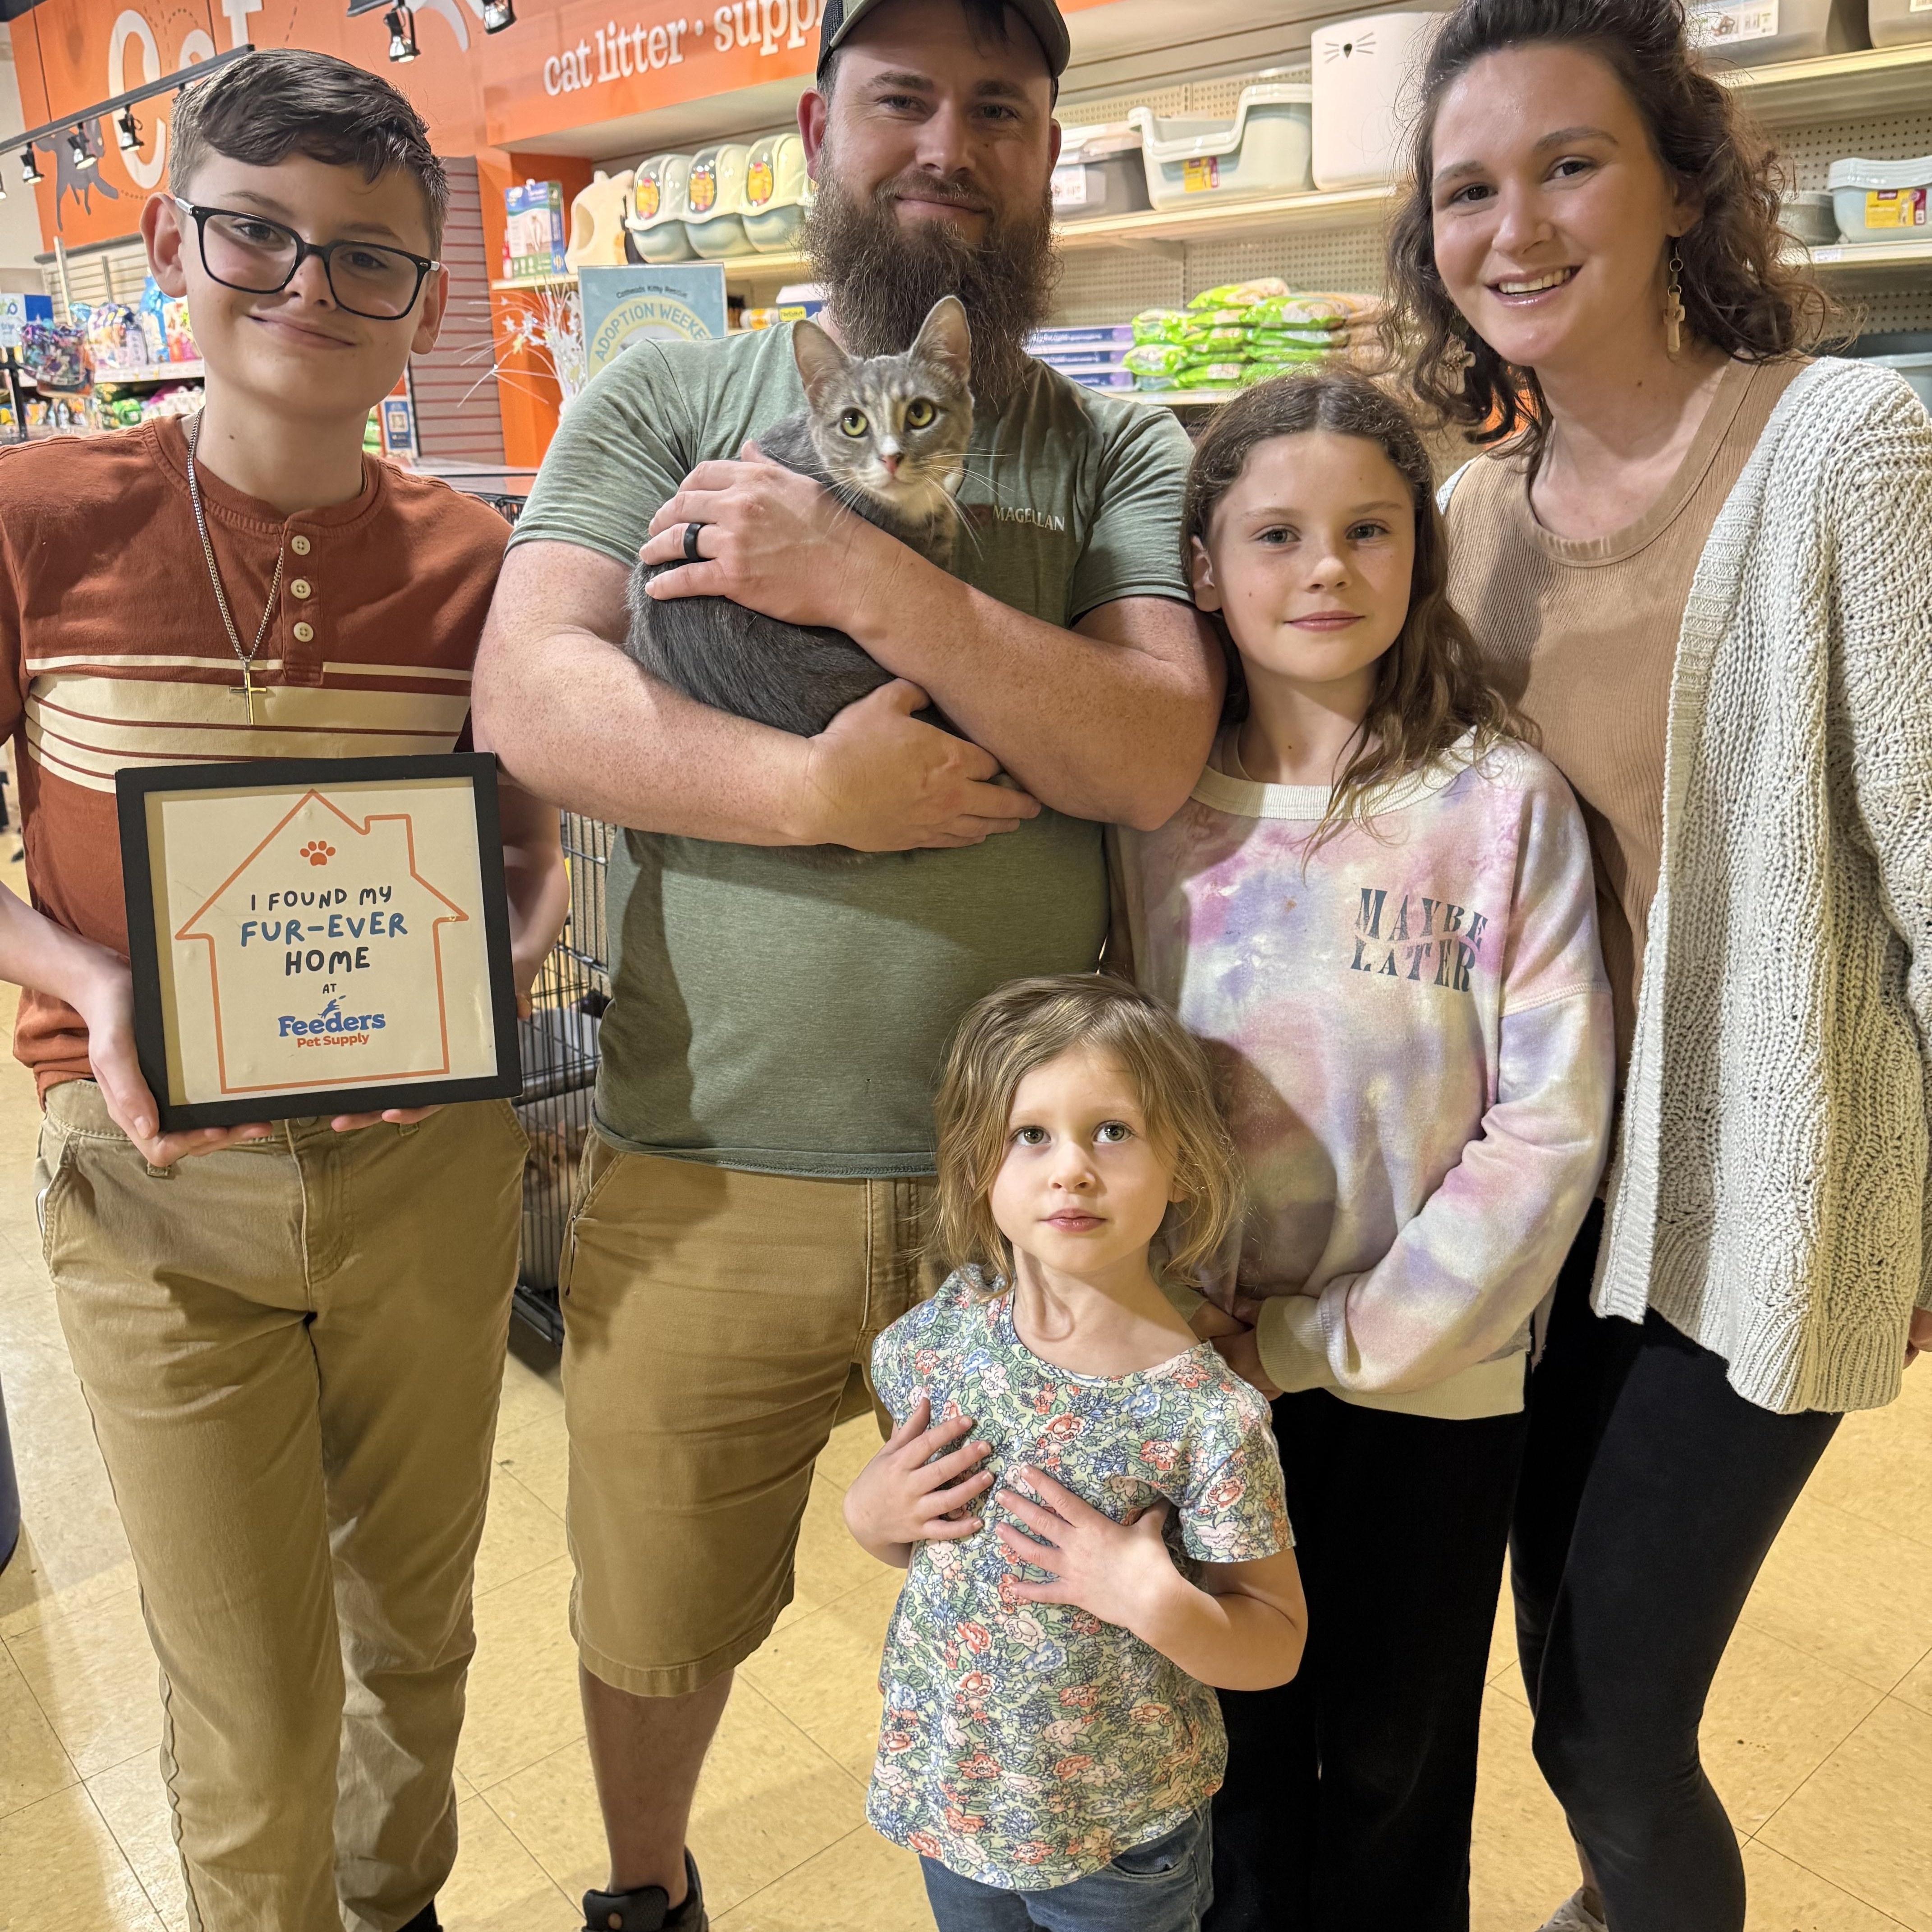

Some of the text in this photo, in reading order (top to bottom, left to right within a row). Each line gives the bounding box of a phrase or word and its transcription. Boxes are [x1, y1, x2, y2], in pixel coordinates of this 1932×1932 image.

[543, 0, 822, 96] cat litter supp
[595, 303, 655, 363] ADOPTION
[993, 505, 1065, 531] MAGELLAN
[251, 894, 256, 911] I
[268, 888, 348, 911] FOUND
[241, 911, 408, 947] FUR-EVER
[1354, 888, 1488, 952] MAYBE
[285, 946, 370, 976] HOME
[1350, 934, 1476, 992] LATER
[322, 983, 337, 994] AT
[277, 1011, 386, 1037] Feeders
[297, 1033, 370, 1048] Pet Supply
